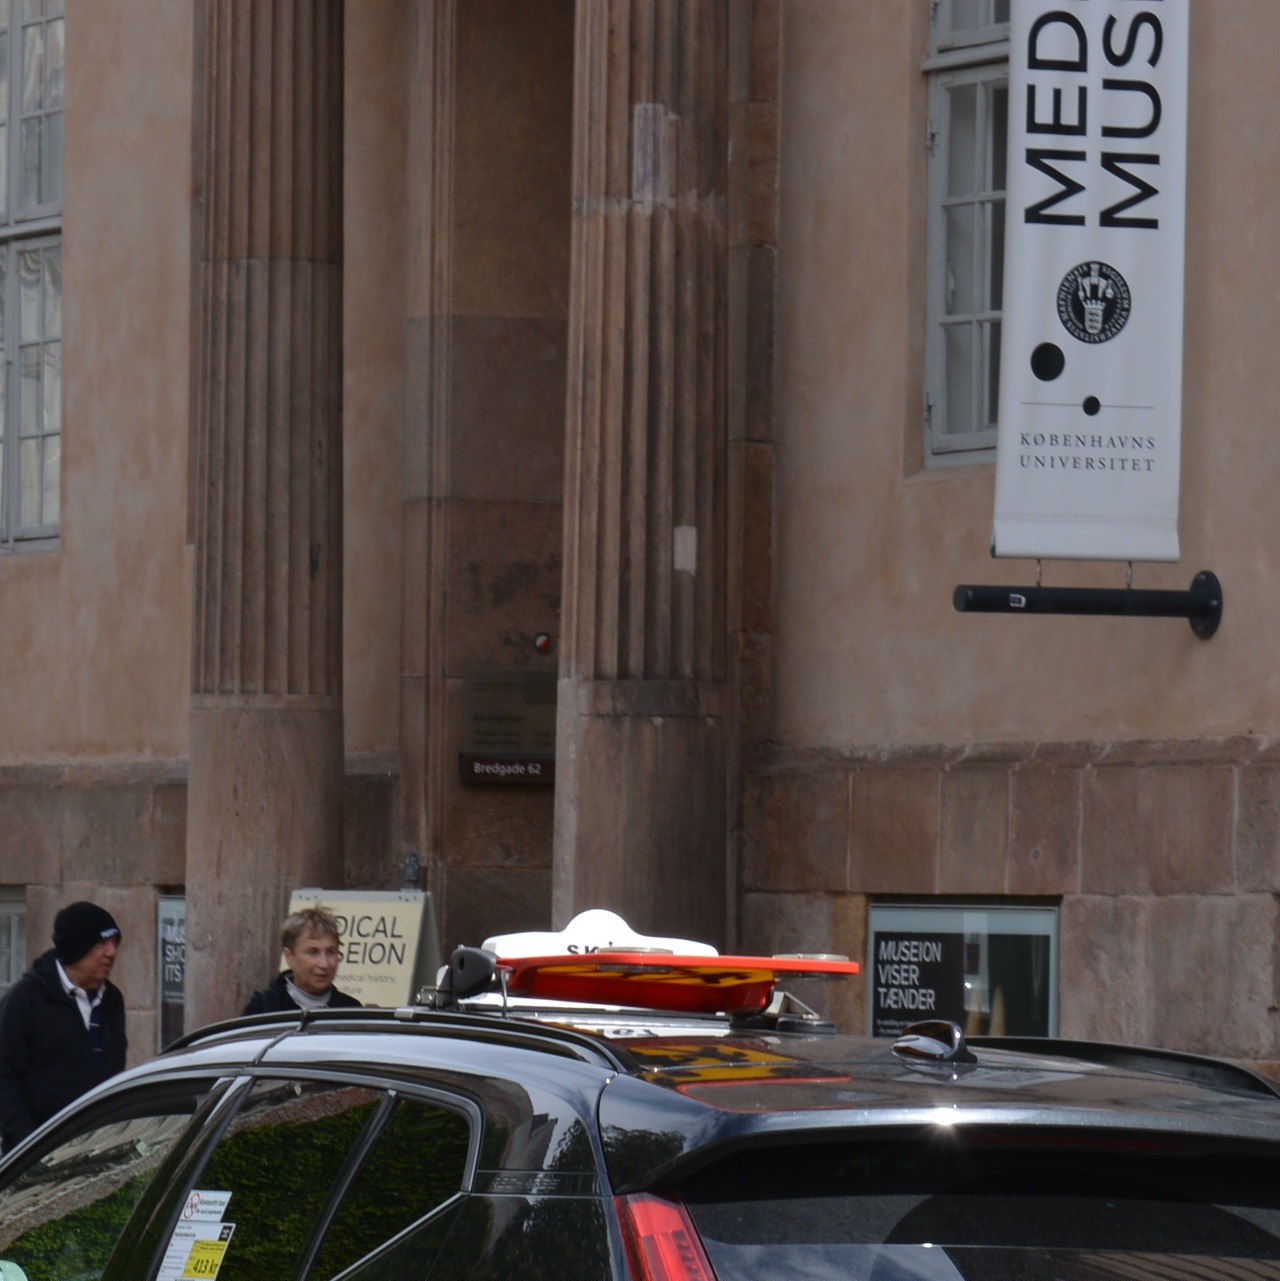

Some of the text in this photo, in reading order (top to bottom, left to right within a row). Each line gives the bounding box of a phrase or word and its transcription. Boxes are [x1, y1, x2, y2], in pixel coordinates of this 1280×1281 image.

[1024, 9, 1088, 226] MED
[1099, 10, 1163, 230] MUS
[1019, 432, 1156, 451] KØBENHAVNS
[1019, 454, 1156, 472] UNIVERSITET
[473, 762, 541, 777] Bredgade 62
[336, 915, 403, 939] DICAL
[165, 943, 186, 962] SHO
[338, 941, 406, 965] SEION
[879, 940, 942, 962] MUSEION
[165, 963, 182, 983] ITS
[878, 963, 919, 986] VISER
[877, 988, 935, 1010] TÆNDER
[192, 1258, 219, 1275] 413 kr
